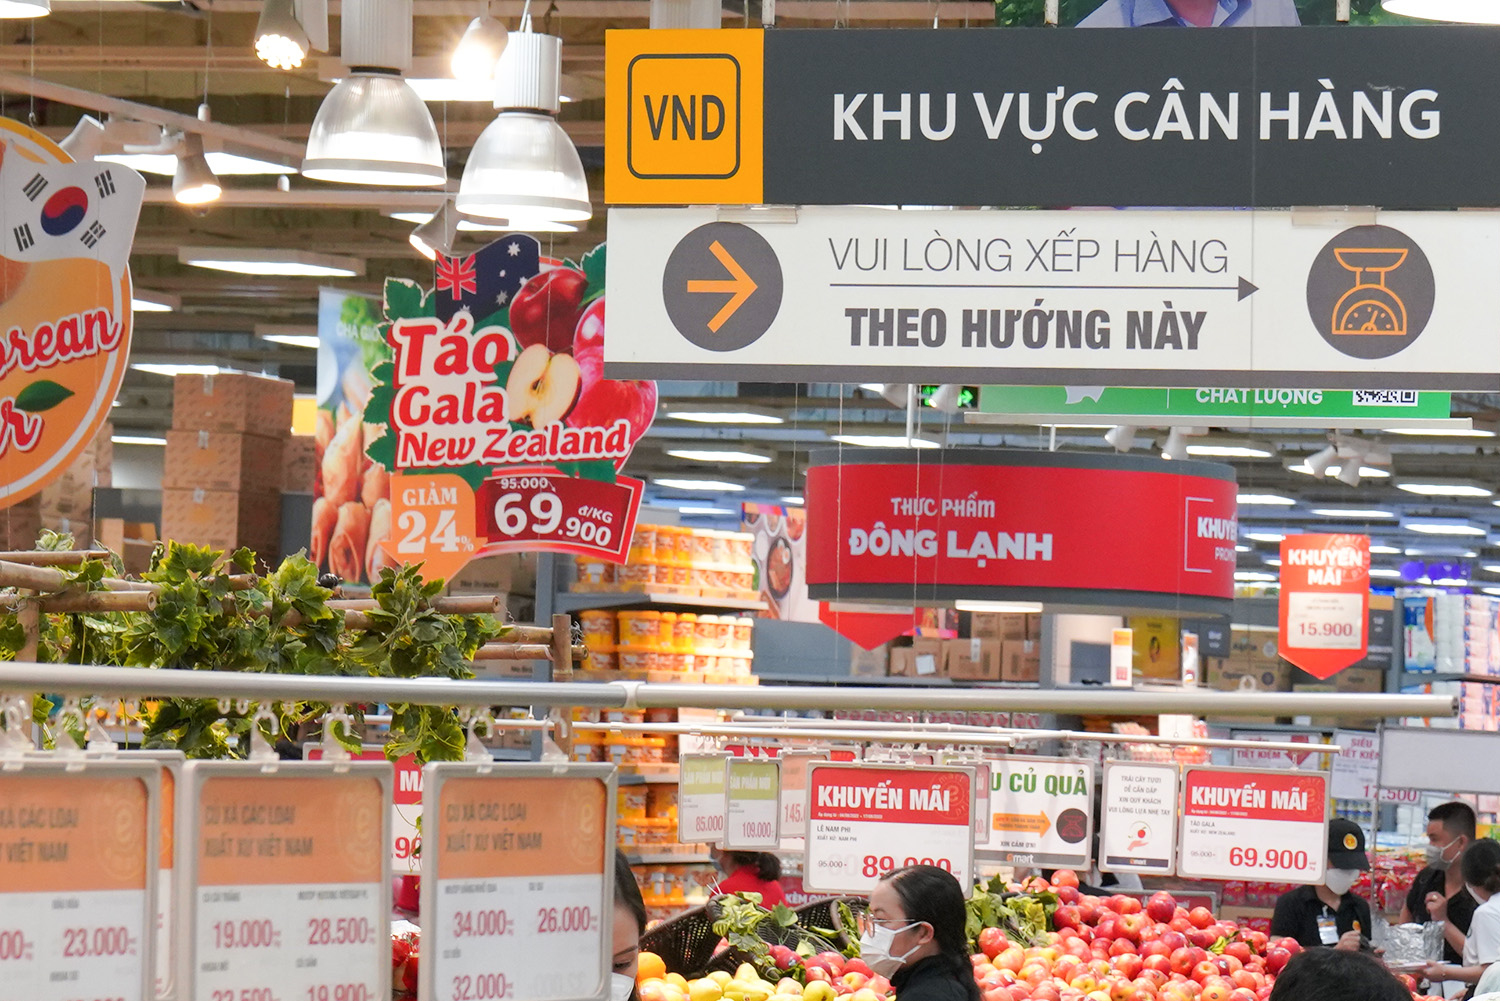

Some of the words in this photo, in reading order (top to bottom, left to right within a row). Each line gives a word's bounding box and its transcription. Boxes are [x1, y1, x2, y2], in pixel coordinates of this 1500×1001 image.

[643, 94, 726, 142] VND
[834, 93, 958, 142] KHU
[973, 86, 1098, 155] VỰC
[1114, 78, 1240, 142] CÂN
[1261, 79, 1442, 141] HÀNG
[829, 238, 890, 272] VUI
[904, 227, 1014, 273] LÒNG
[1025, 229, 1101, 273] XẾP
[1116, 228, 1230, 273] HÀNG
[845, 308, 947, 348] THEO
[962, 298, 1114, 350] HƯỚNG
[1128, 304, 1208, 350] NÀY
[0, 309, 122, 370] rean
[399, 319, 510, 377] Táo
[398, 382, 505, 426] Gala
[400, 432, 477, 464] New
[482, 423, 630, 460] Zealand
[402, 481, 458, 506] GIẢM
[500, 477, 549, 490] 95.000
[494, 492, 613, 548] 69.900
[577, 504, 614, 524] đ/KG
[890, 496, 938, 521] THỰC
[848, 520, 938, 558] ĐÔNG
[947, 531, 1053, 568] LẠNH
[1287, 546, 1363, 567] KHUYẾN
[1307, 567, 1342, 586] MÃI
[1299, 623, 1353, 637] 15.900
[1351, 737, 1373, 748] SIÊU
[1009, 767, 1037, 793] CỦ
[1045, 768, 1088, 797] QUẢ
[1121, 775, 1134, 783] TRÁI
[1135, 775, 1146, 783] CÂY
[818, 780, 903, 810] KHUYẾN
[909, 784, 950, 811] MÃI
[1191, 783, 1266, 808] KHUYẾN
[1271, 788, 1307, 811] MÃI
[695, 815, 723, 832] 85.000
[1190, 819, 1200, 827] TÁO
[1006, 853, 1034, 864] emart
[1229, 847, 1308, 870] 69.900
[307, 917, 368, 946] 28.500
[453, 910, 507, 938] 34.000
[537, 906, 591, 933] 26.000
[63, 926, 128, 958] 23.000
[212, 919, 274, 949] 19.000
[452, 973, 507, 1001] 32.000
